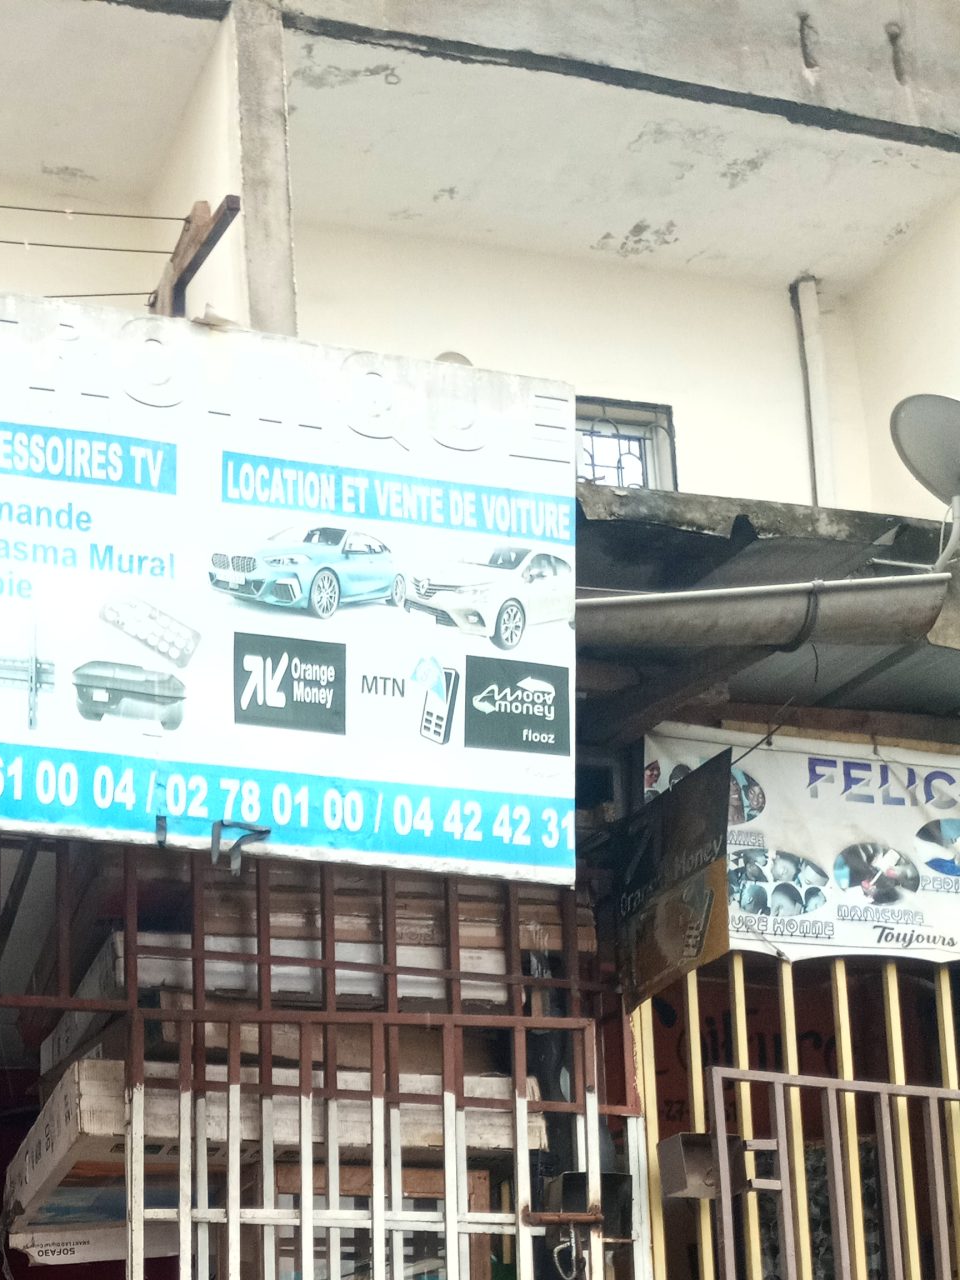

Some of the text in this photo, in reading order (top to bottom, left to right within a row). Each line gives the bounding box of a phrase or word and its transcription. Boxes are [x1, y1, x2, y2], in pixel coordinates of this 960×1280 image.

[131, 447, 163, 487] TV
[228, 462, 573, 547] LOCATION ET VENTE DE VOITURE
[90, 543, 174, 577] Mural
[291, 656, 336, 687] Orange
[293, 681, 334, 709] Money
[361, 675, 406, 697] MTN
[495, 700, 556, 720] money
[522, 728, 556, 744] flooz
[807, 757, 960, 810] FELIC
[36, 761, 78, 805] 00
[94, 766, 135, 809] 04
[167, 775, 207, 816] 02
[221, 779, 260, 822] 78
[273, 784, 308, 826] 01
[324, 789, 363, 830] 00
[394, 796, 433, 836] 04
[444, 800, 482, 840] 42
[493, 805, 530, 844] 42
[543, 809, 575, 849] 31
[730, 914, 835, 936] UPE HOMME
[837, 904, 925, 924] MANICURE
[873, 925, 958, 948] Toujours
